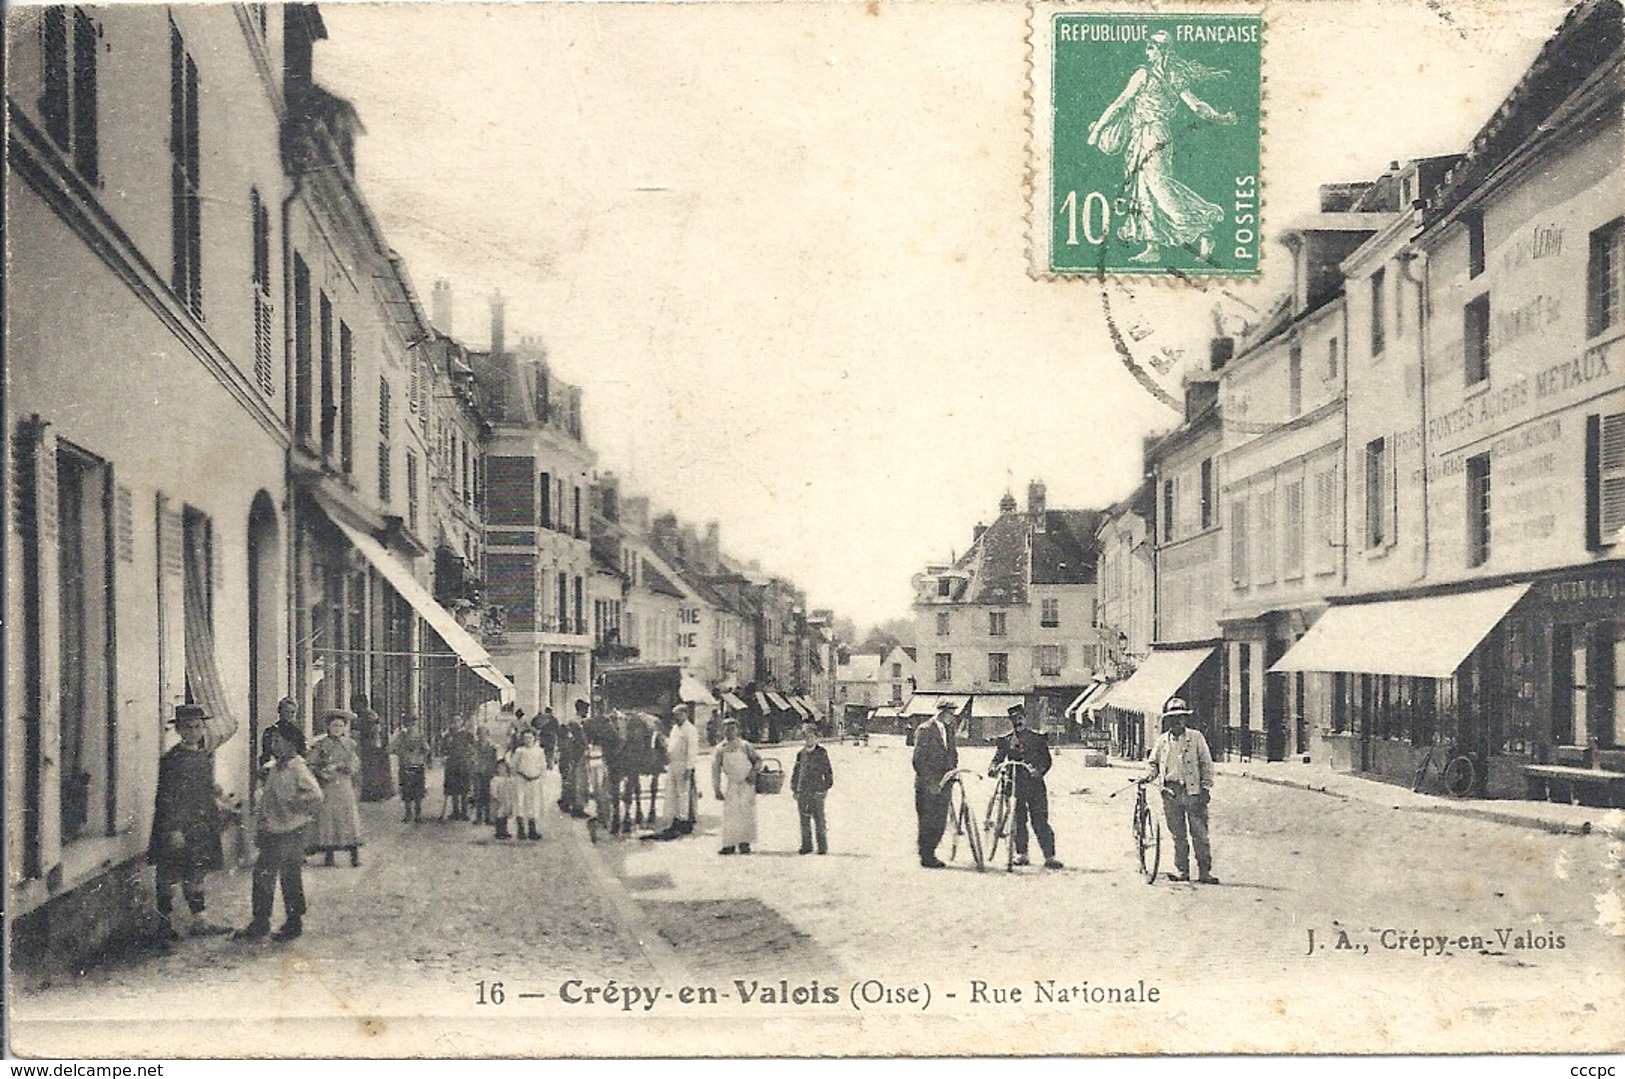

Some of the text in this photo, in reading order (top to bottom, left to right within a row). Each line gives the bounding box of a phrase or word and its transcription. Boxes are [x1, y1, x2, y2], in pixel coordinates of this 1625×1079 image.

[1060, 23, 1258, 44] REPUBLIQUE FRANÇAISE
[1234, 174, 1255, 259] POSTES
[1535, 347, 1612, 400] METAUX
